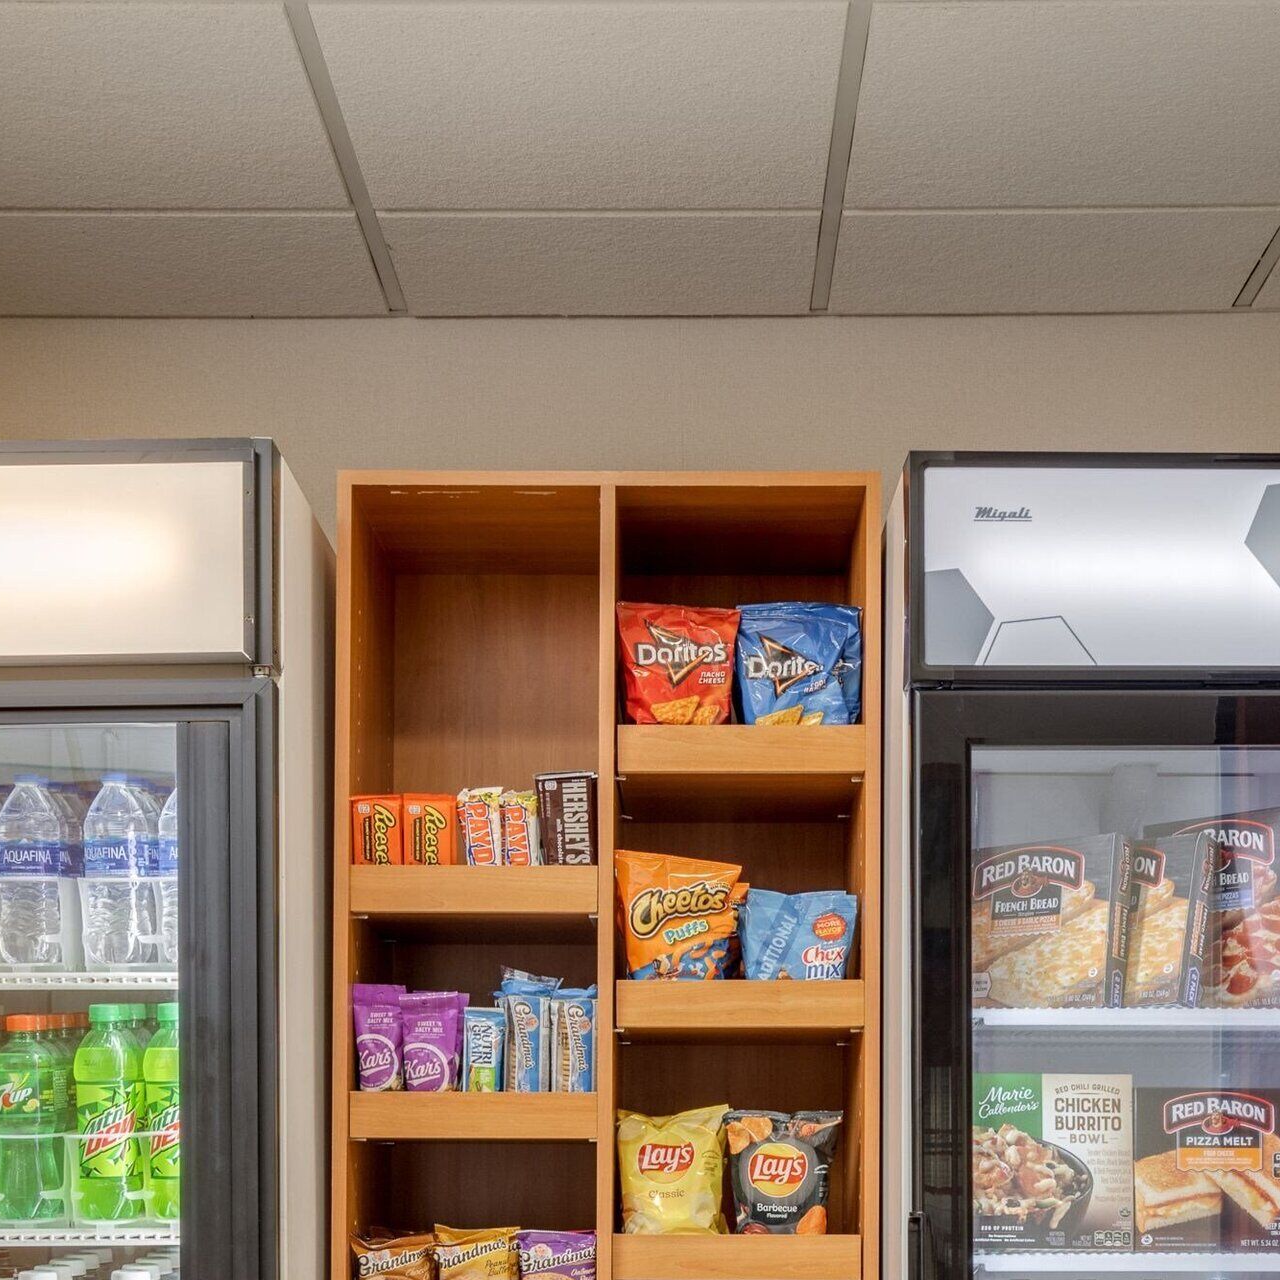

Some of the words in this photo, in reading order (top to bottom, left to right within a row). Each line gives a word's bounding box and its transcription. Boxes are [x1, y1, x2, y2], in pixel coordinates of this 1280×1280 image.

[975, 507, 1032, 521] Migali
[637, 641, 727, 665] Doritos
[561, 781, 591, 865] HERSHEY'S
[4, 850, 53, 864] AQUAFINA
[981, 862, 1015, 887] RED
[1018, 855, 1076, 877] BARON
[1220, 872, 1249, 886] BREAD
[630, 882, 727, 934] Cheetos
[995, 900, 1027, 914] FRENCH
[1030, 898, 1059, 911] BREAD
[817, 920, 841, 928] MORE
[803, 946, 846, 963] Chex
[470, 1024, 483, 1064] GRAIN
[513, 1001, 534, 1070] Grandma's
[568, 1004, 587, 1072] Grandma's
[480, 1024, 492, 1067] NUTRI
[359, 1049, 391, 1070] Kar's
[404, 1059, 440, 1080] Kar's
[979, 1087, 1034, 1104] Marie
[1055, 1085, 1068, 1095] RED
[1092, 1084, 1120, 1095] GRILLED
[978, 1101, 1037, 1119] Callender's
[1055, 1098, 1120, 1113] CHICKEN
[1172, 1101, 1204, 1123] RED
[1207, 1098, 1266, 1122] BARON
[1055, 1116, 1121, 1131] BURRITO
[1070, 1134, 1108, 1144] BOWL
[1186, 1137, 1220, 1146] PIZZA
[1224, 1137, 1253, 1146] MELT
[642, 1141, 692, 1173] Lay's
[753, 1156, 803, 1185] Lay's
[648, 1189, 685, 1199] Classic
[757, 1202, 798, 1213] Barbecue
